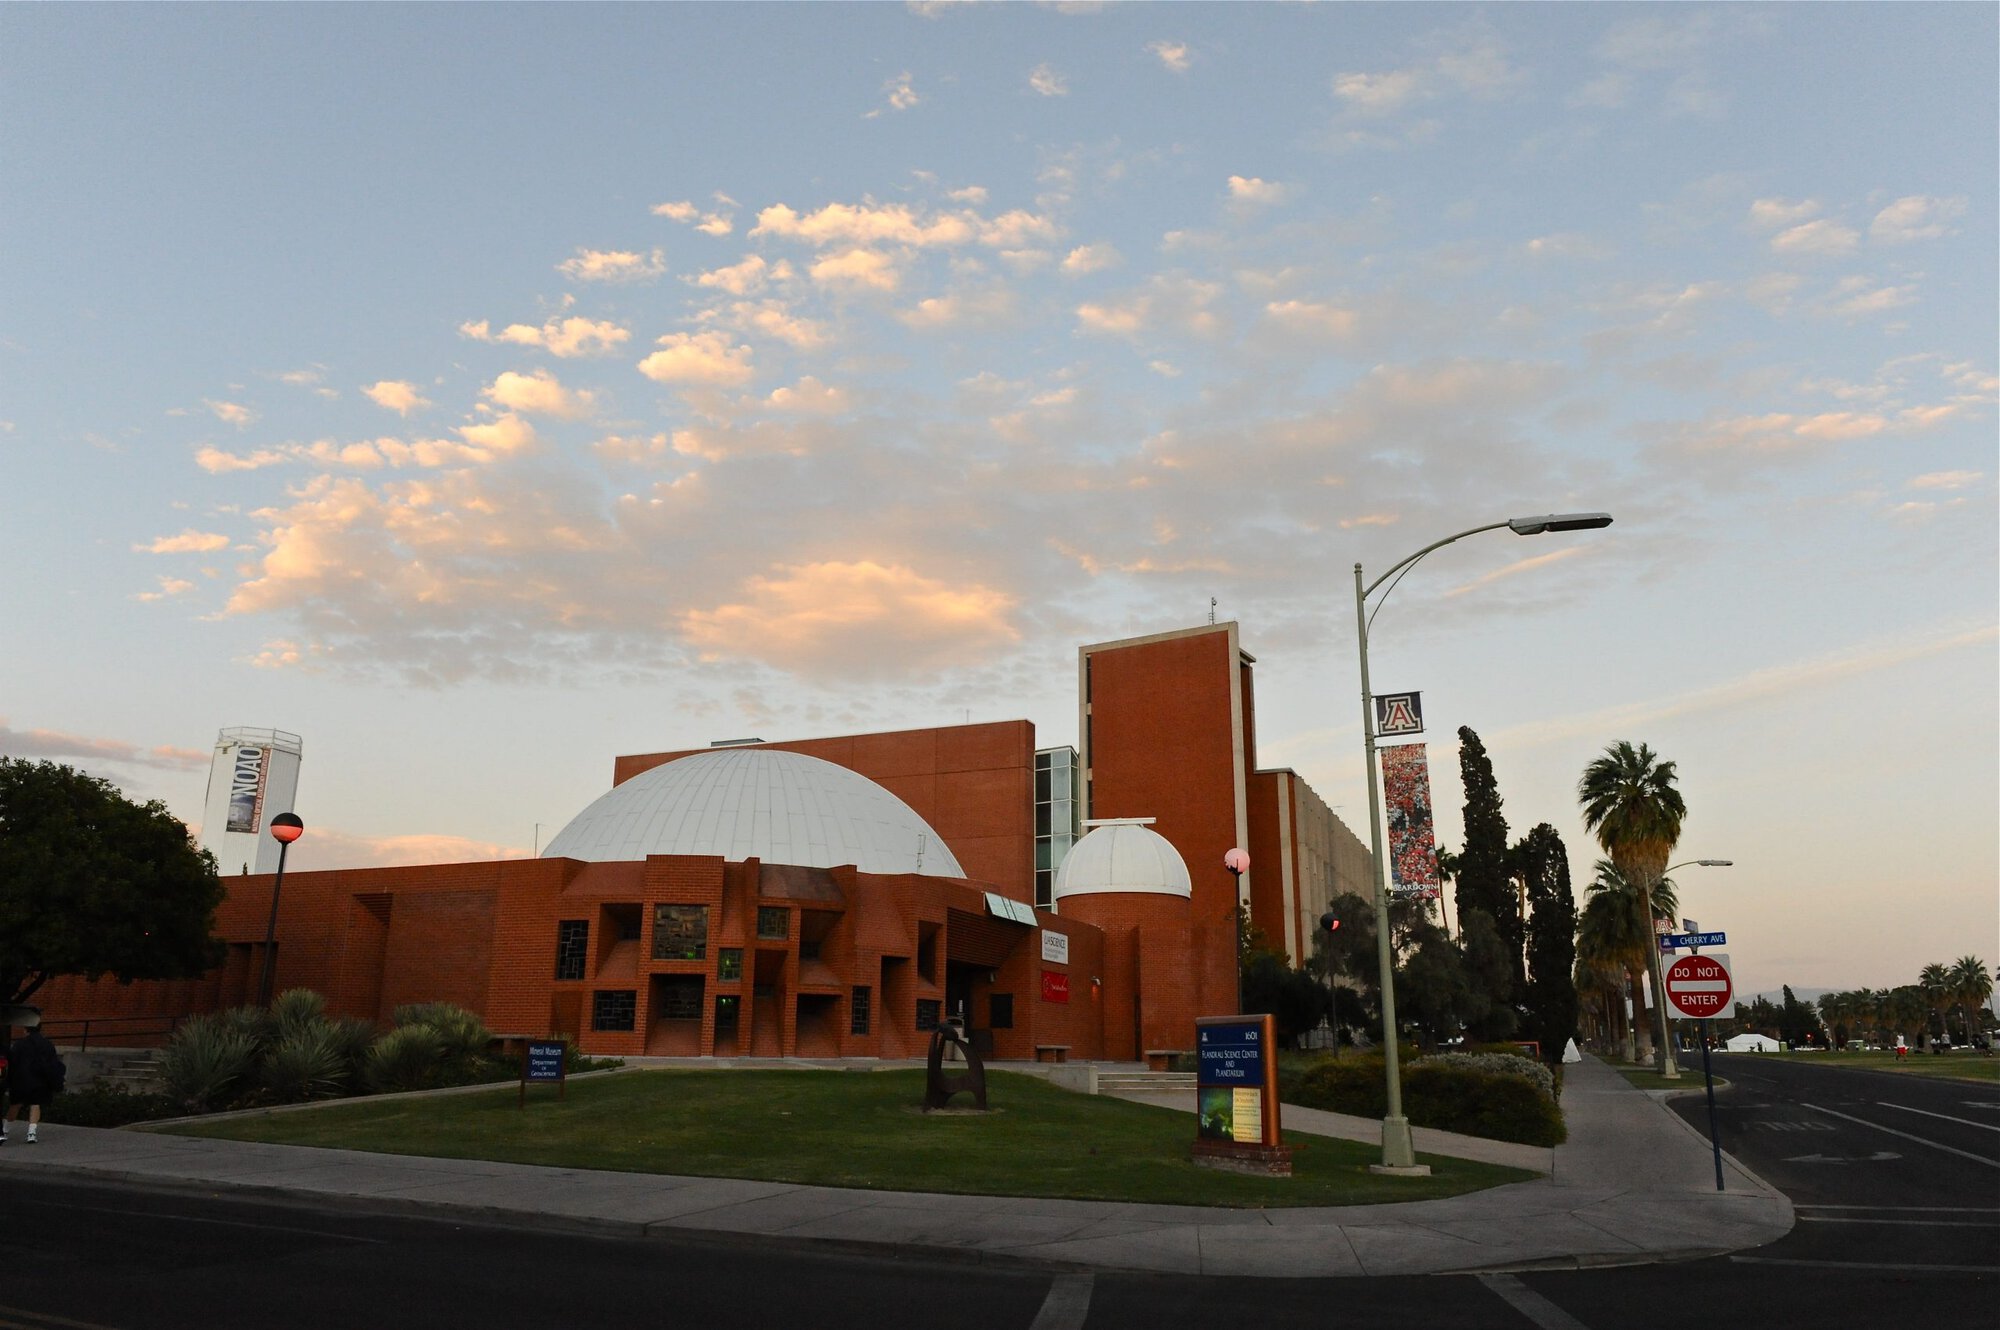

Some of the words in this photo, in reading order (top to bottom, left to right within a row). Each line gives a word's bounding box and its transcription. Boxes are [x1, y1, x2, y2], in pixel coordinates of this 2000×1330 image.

[231, 747, 263, 797] NOAO
[1680, 936, 1708, 945] CHERRY
[1711, 934, 1725, 943] AVE
[1674, 967, 1690, 978] DO
[1697, 967, 1719, 977] NOT
[1681, 995, 1718, 1005] ENTER
[1245, 1031, 1258, 1040] 1601
